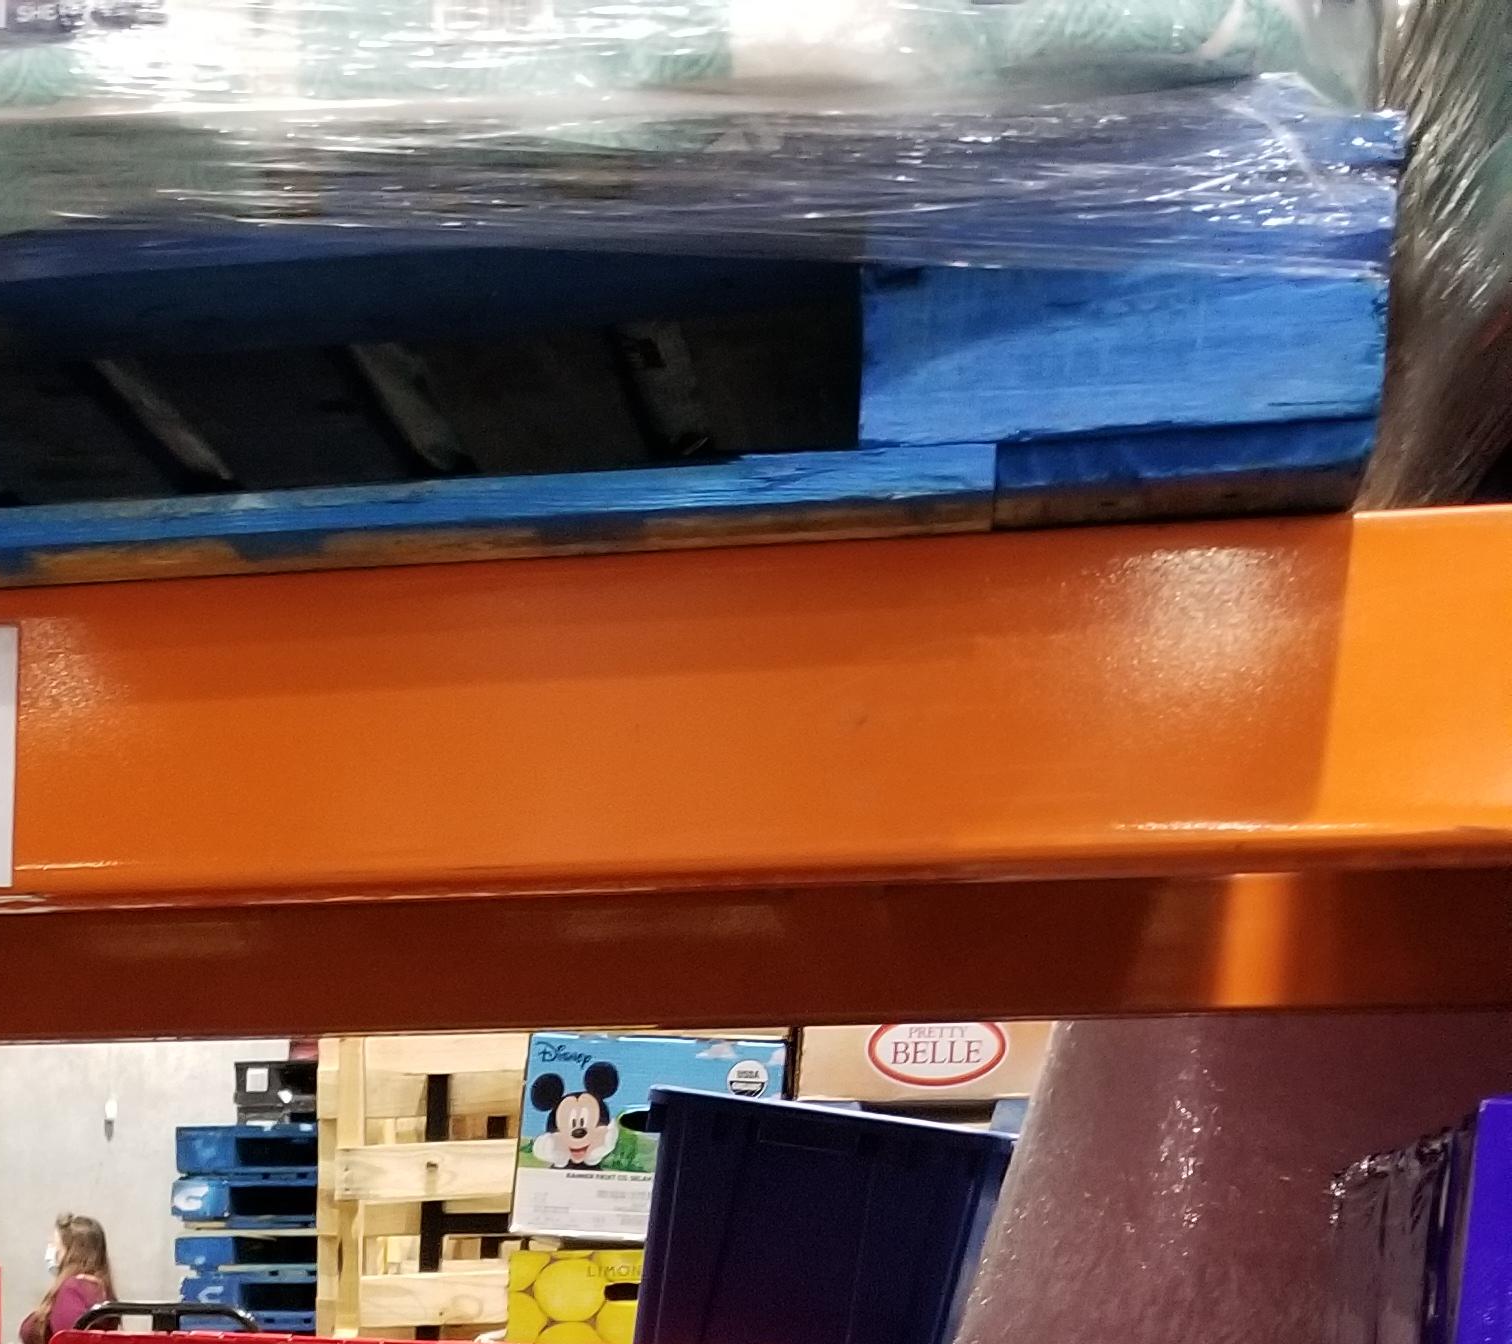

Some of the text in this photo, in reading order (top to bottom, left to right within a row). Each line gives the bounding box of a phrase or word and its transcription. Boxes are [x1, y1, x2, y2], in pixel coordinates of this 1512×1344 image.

[908, 1026, 967, 1038] PRETTY
[536, 1041, 592, 1069] Disney
[891, 1040, 983, 1065] BELLE
